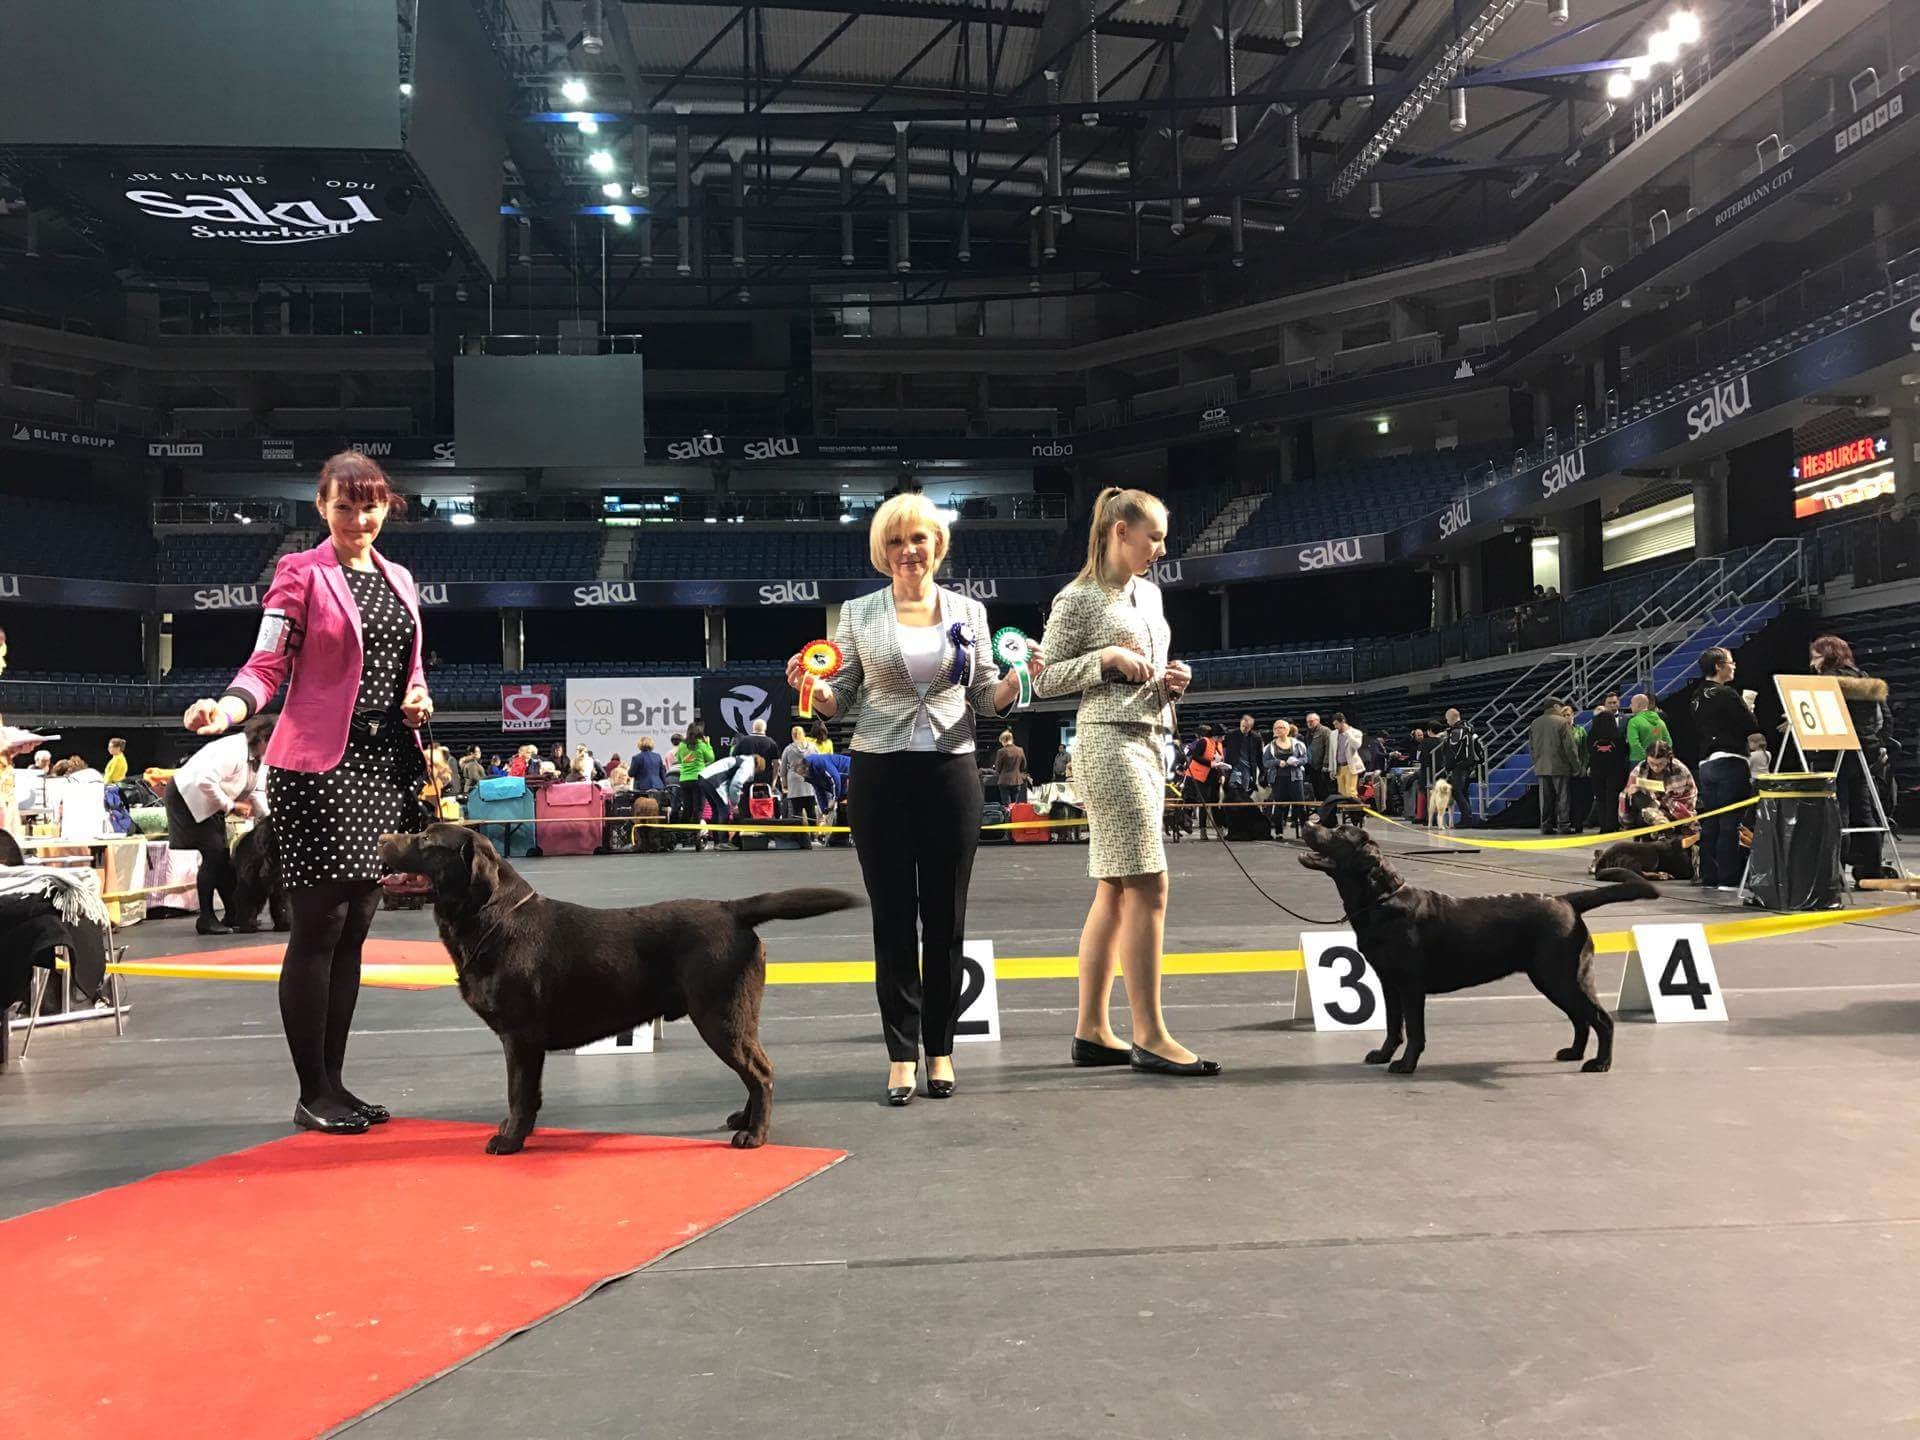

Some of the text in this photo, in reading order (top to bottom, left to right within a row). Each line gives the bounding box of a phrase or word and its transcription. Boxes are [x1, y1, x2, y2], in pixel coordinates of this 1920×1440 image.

[1835, 94, 1903, 153] CRAMO
[126, 188, 382, 226] saku
[1714, 166, 1795, 227] ROTERMANN CITY
[191, 221, 354, 243] Suurhall
[1582, 288, 1604, 311] SEB
[1687, 375, 1752, 441] saku
[34, 429, 115, 448] BLRT GRUPP
[352, 443, 391, 456] BMW
[667, 437, 724, 460] saku
[744, 437, 800, 460] saku
[1032, 442, 1073, 457] naba
[1802, 438, 1876, 478] HESBURGER
[1541, 448, 1587, 499] saku
[1439, 498, 1472, 540] saku
[1298, 538, 1363, 572] saku
[194, 584, 260, 610] saku
[573, 581, 638, 606] saku
[759, 579, 820, 605] saku
[621, 698, 687, 727] Brit
[1799, 701, 1817, 730] 6
[1318, 945, 1377, 1025] 3
[1659, 938, 1712, 1010] 4
[953, 955, 989, 1034] 2
